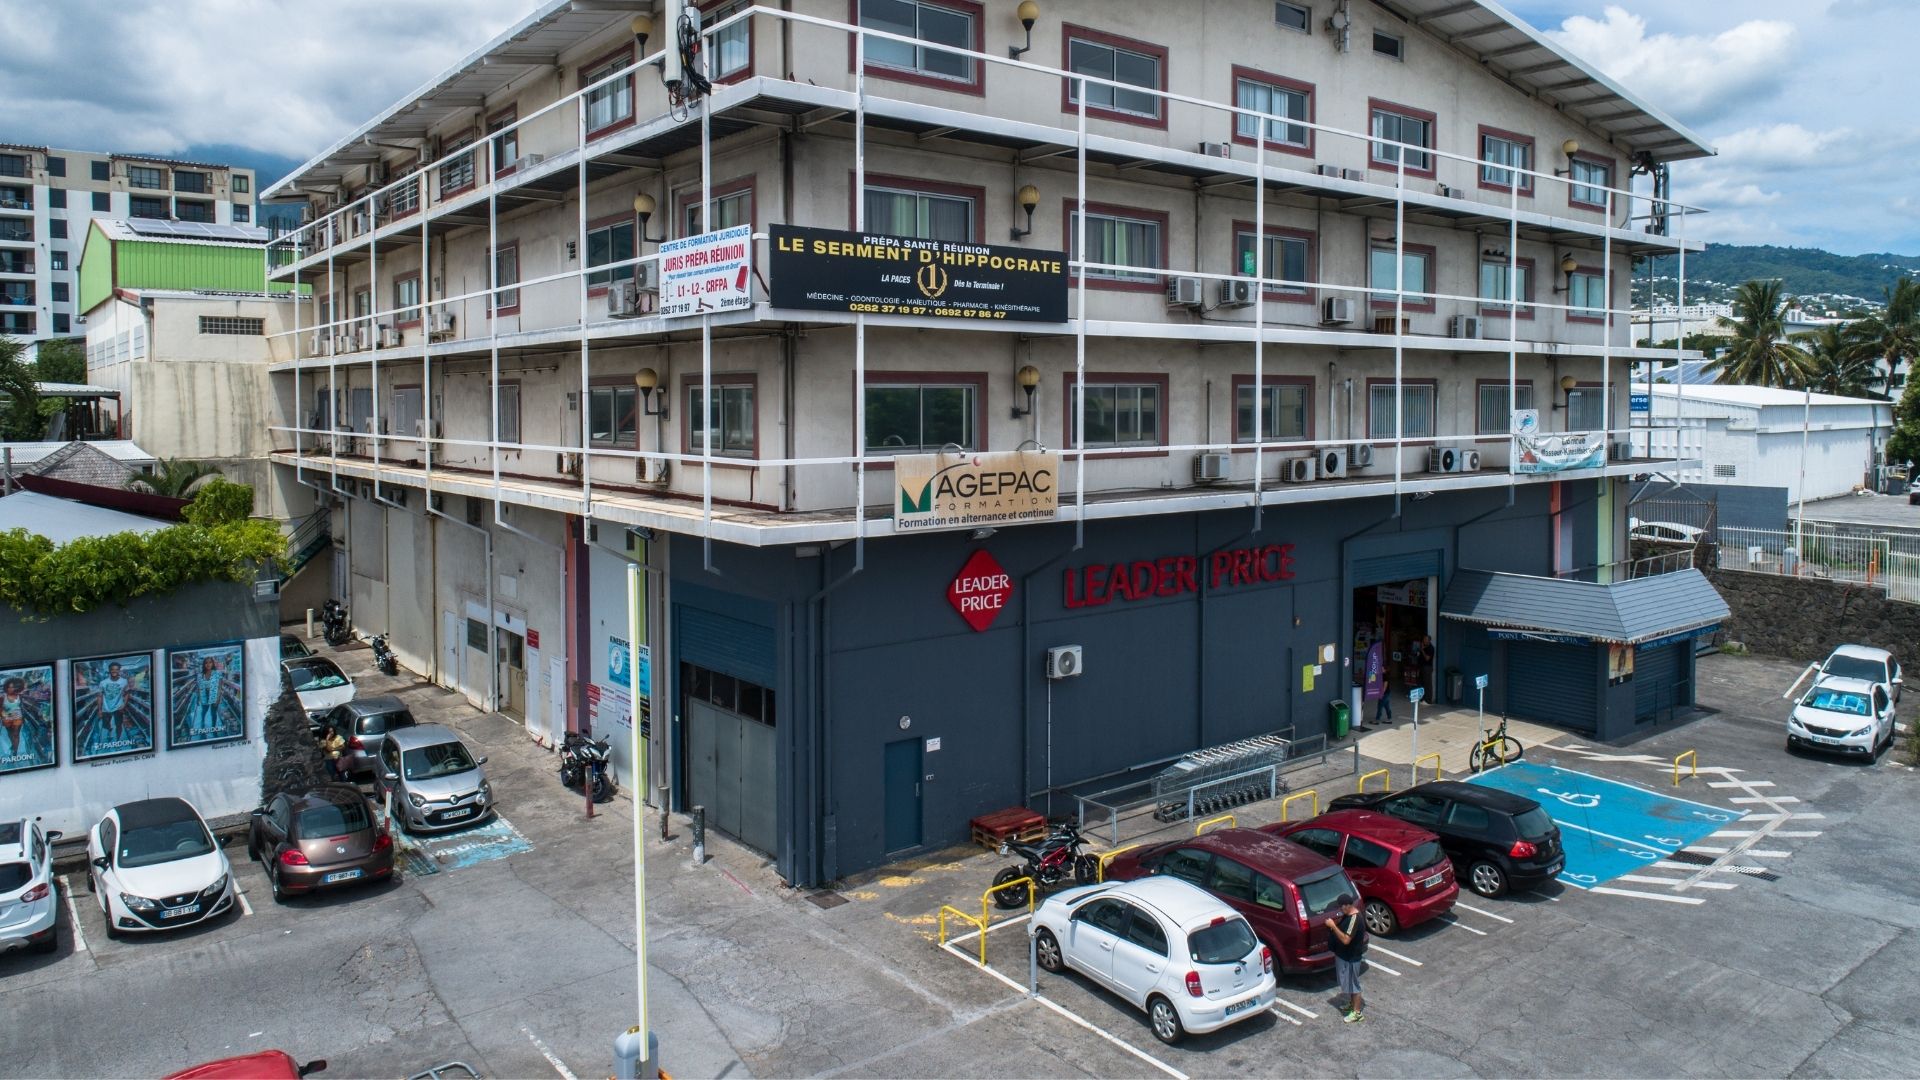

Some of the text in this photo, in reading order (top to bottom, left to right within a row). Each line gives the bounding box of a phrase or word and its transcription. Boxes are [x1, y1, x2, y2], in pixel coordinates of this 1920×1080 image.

[660, 226, 749, 253] CENTRE DE FORMATION JURIDIQUE
[863, 235, 990, 255] PRÉPA SANTÉ RÉUNION
[663, 243, 745, 272] JURIS PRÉPA RÉUNION
[778, 236, 1061, 274] LE SERMENT D'HIPPOCRATE
[677, 284, 685, 297] L1
[691, 282, 700, 295] L2
[706, 278, 728, 293] CRFPA
[881, 274, 911, 284] LA PACES
[973, 280, 1001, 290] Terminale
[806, 291, 844, 301] MÉDECINE
[850, 295, 900, 304] ODONTOLOGIE
[953, 301, 989, 310] PHARMACIE
[849, 303, 1007, 319] 0262 37 19 97 0692 67 86 47
[934, 469, 1051, 499] AGEPAC
[934, 496, 1053, 512] FORMATION
[899, 508, 1054, 529] Formation en alternance et continue
[955, 573, 1010, 594] LEADER
[1064, 543, 1296, 610] LEADER PRICE
[960, 594, 1003, 613] PRICE
